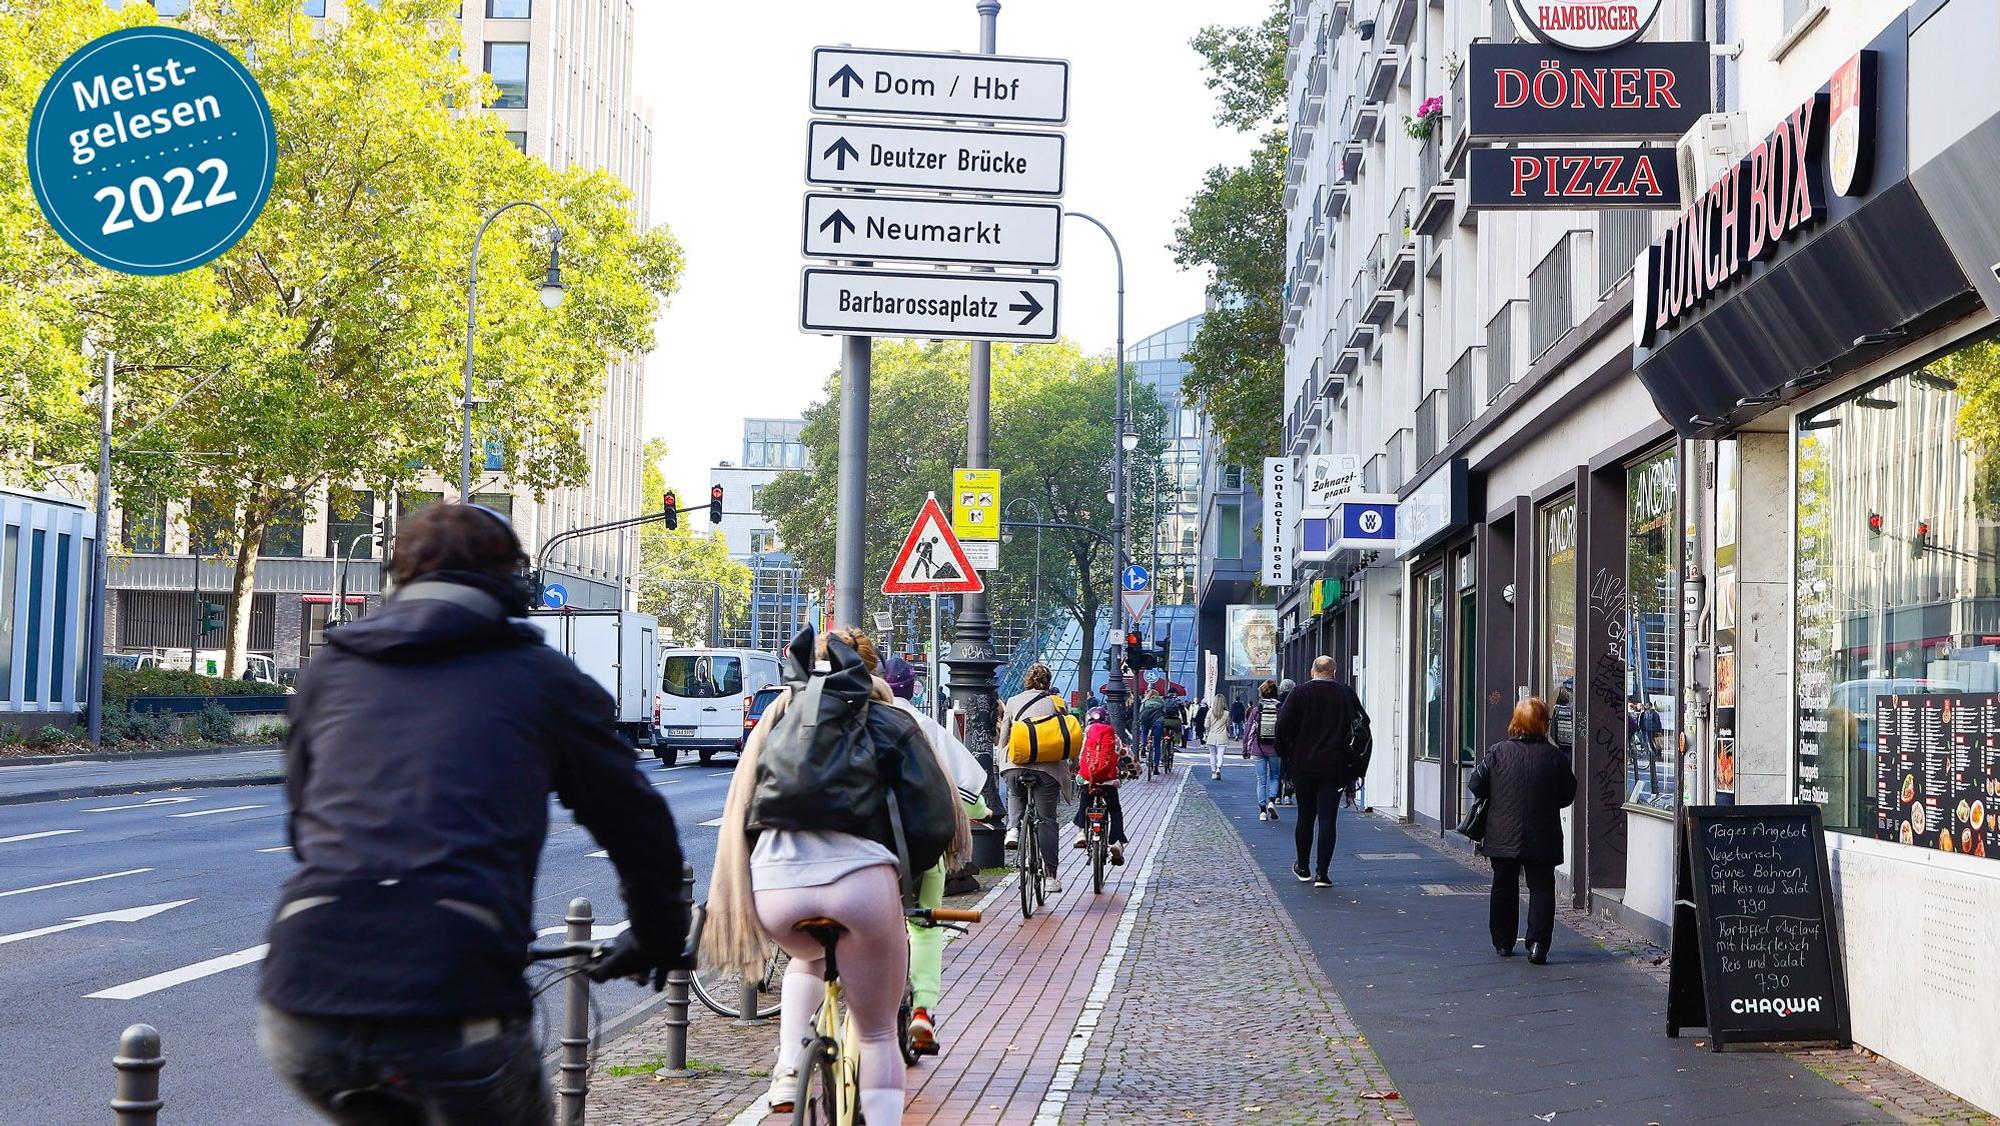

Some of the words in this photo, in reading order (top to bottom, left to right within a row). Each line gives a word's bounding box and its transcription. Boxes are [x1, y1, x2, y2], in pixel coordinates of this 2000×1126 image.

[1538, 5, 1640, 31] HAMBURGER
[874, 71, 935, 97] Dom
[949, 75, 960, 97] /
[973, 76, 1020, 101] Hbf
[1494, 60, 1681, 109] DÖNER
[870, 144, 947, 169] Deutzer
[957, 148, 1027, 174] Brücke
[1510, 155, 1663, 196] PIZZA
[1656, 158, 1741, 331] LUNCH
[1747, 96, 1815, 262] BOX
[866, 216, 1001, 244] Neumarkt
[839, 289, 998, 322] Barbarossaplatz
[1312, 471, 1357, 492] Zahnarzt-
[1324, 485, 1351, 501] praxis
[1273, 464, 1284, 579] Contactlinsen
[1800, 739, 1818, 755] Chicken
[1799, 762, 1818, 782] Nuggets
[1799, 784, 1811, 801] Pizza
[1709, 823, 1746, 844] Tages
[1752, 822, 1807, 843] Angebot
[1706, 845, 1782, 866] Vegetarisch
[1753, 863, 1801, 878] Bohnen
[1711, 880, 1726, 894] mit
[1732, 880, 1753, 894] Reis
[1757, 881, 1775, 894] und
[1781, 875, 1809, 895] Salat
[1719, 919, 1770, 938] Kartoffel
[1716, 936, 1736, 953] mit
[1721, 955, 1741, 973] Reis
[1747, 953, 1766, 969] und
[1773, 951, 1806, 968] Salat
[1730, 997, 1821, 1017] CHAQWA
